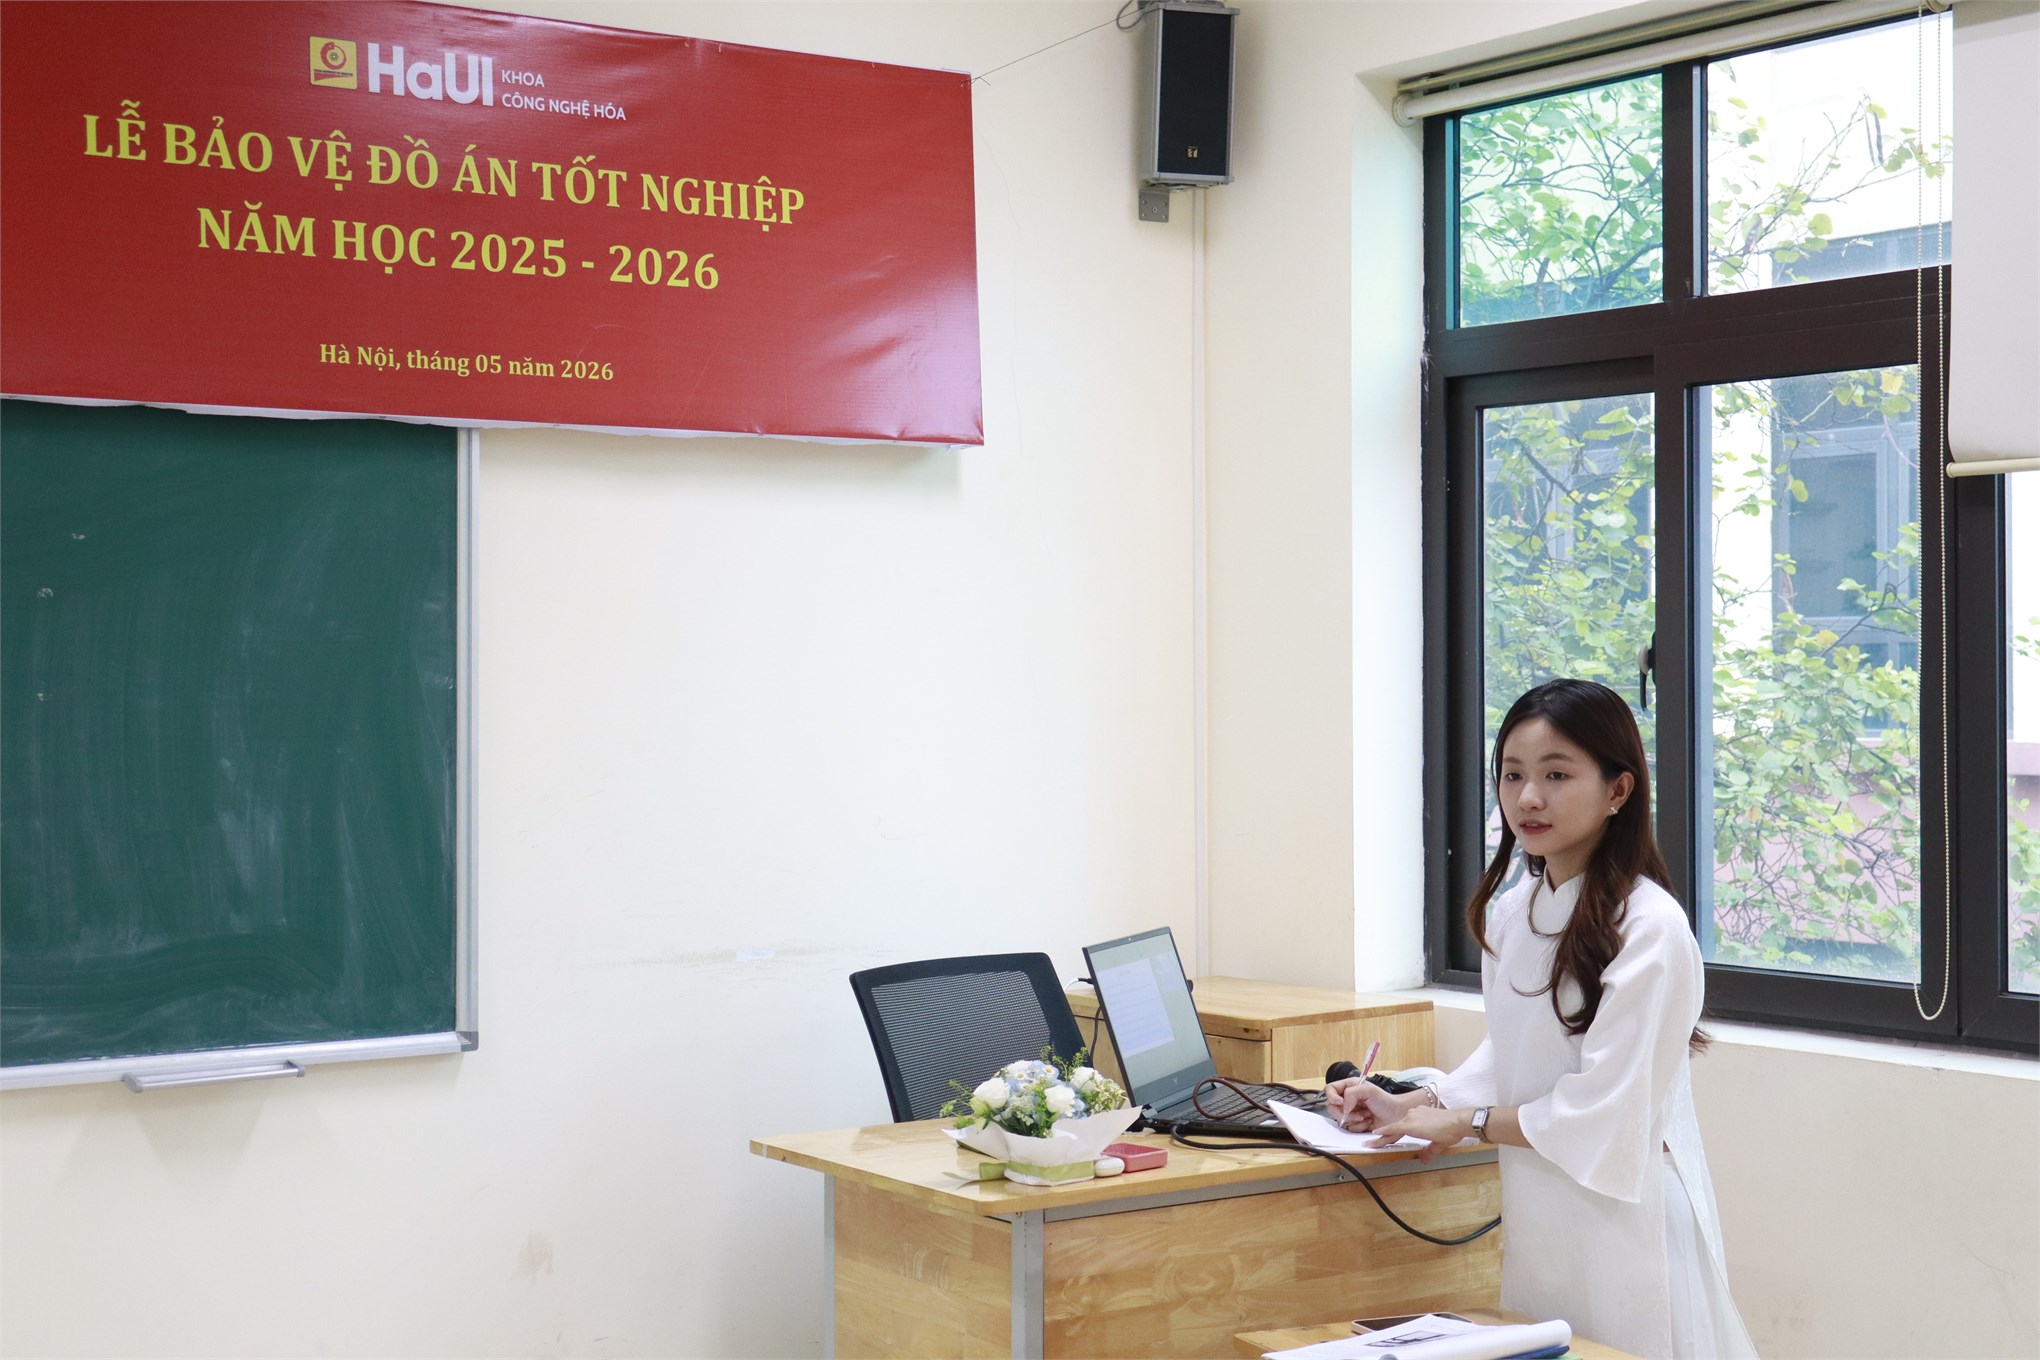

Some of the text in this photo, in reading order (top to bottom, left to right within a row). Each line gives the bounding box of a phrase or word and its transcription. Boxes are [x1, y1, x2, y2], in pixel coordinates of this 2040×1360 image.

[367, 43, 494, 107] HaUI
[501, 69, 545, 88] KHOA
[502, 91, 627, 121] CÔNG NGHỆ HÓA
[83, 99, 805, 233] LỄ BẢO VỆ ĐỒ ÁN TỐT NGHIỆP
[197, 200, 720, 290] NĂM HỌC 2025 - 2026
[320, 343, 614, 381] Hà Nội, tháng 05 năm 2026
